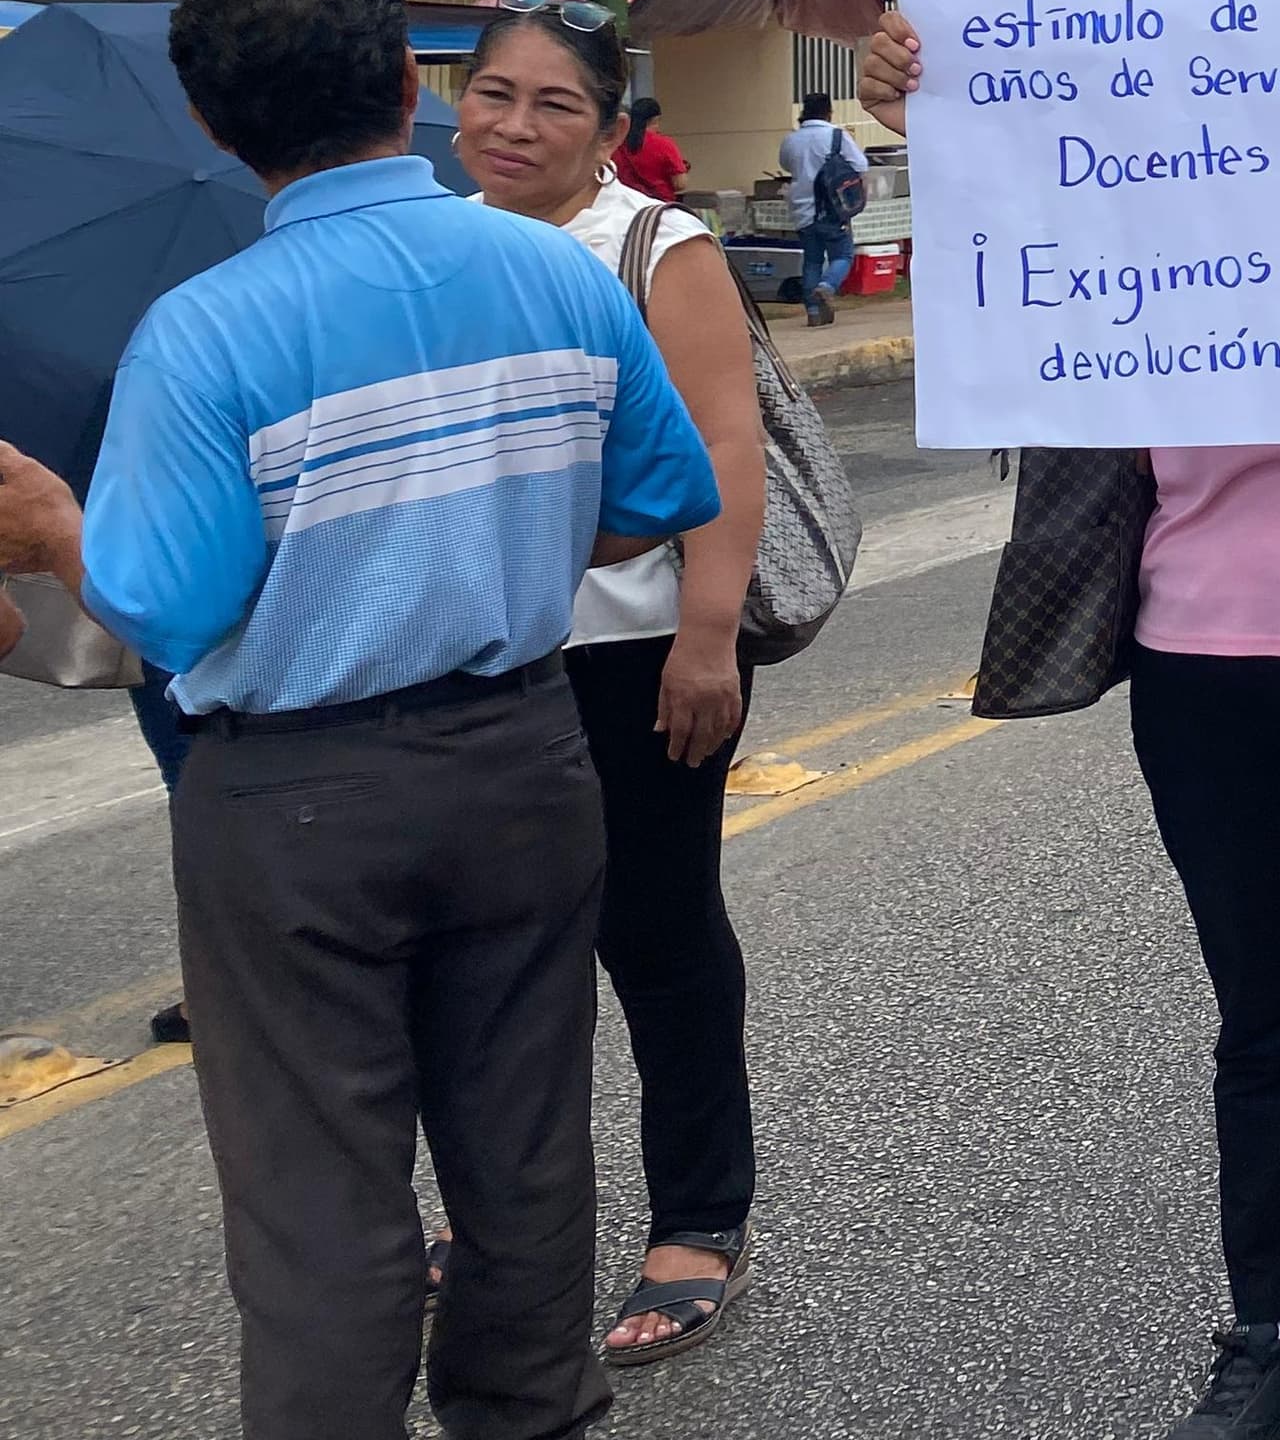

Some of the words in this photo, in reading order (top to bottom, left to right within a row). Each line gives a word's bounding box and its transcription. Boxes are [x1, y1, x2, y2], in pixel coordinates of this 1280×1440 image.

[967, 69, 1079, 106] años
[1110, 58, 1155, 98] de
[1057, 123, 1271, 190] Docentes
